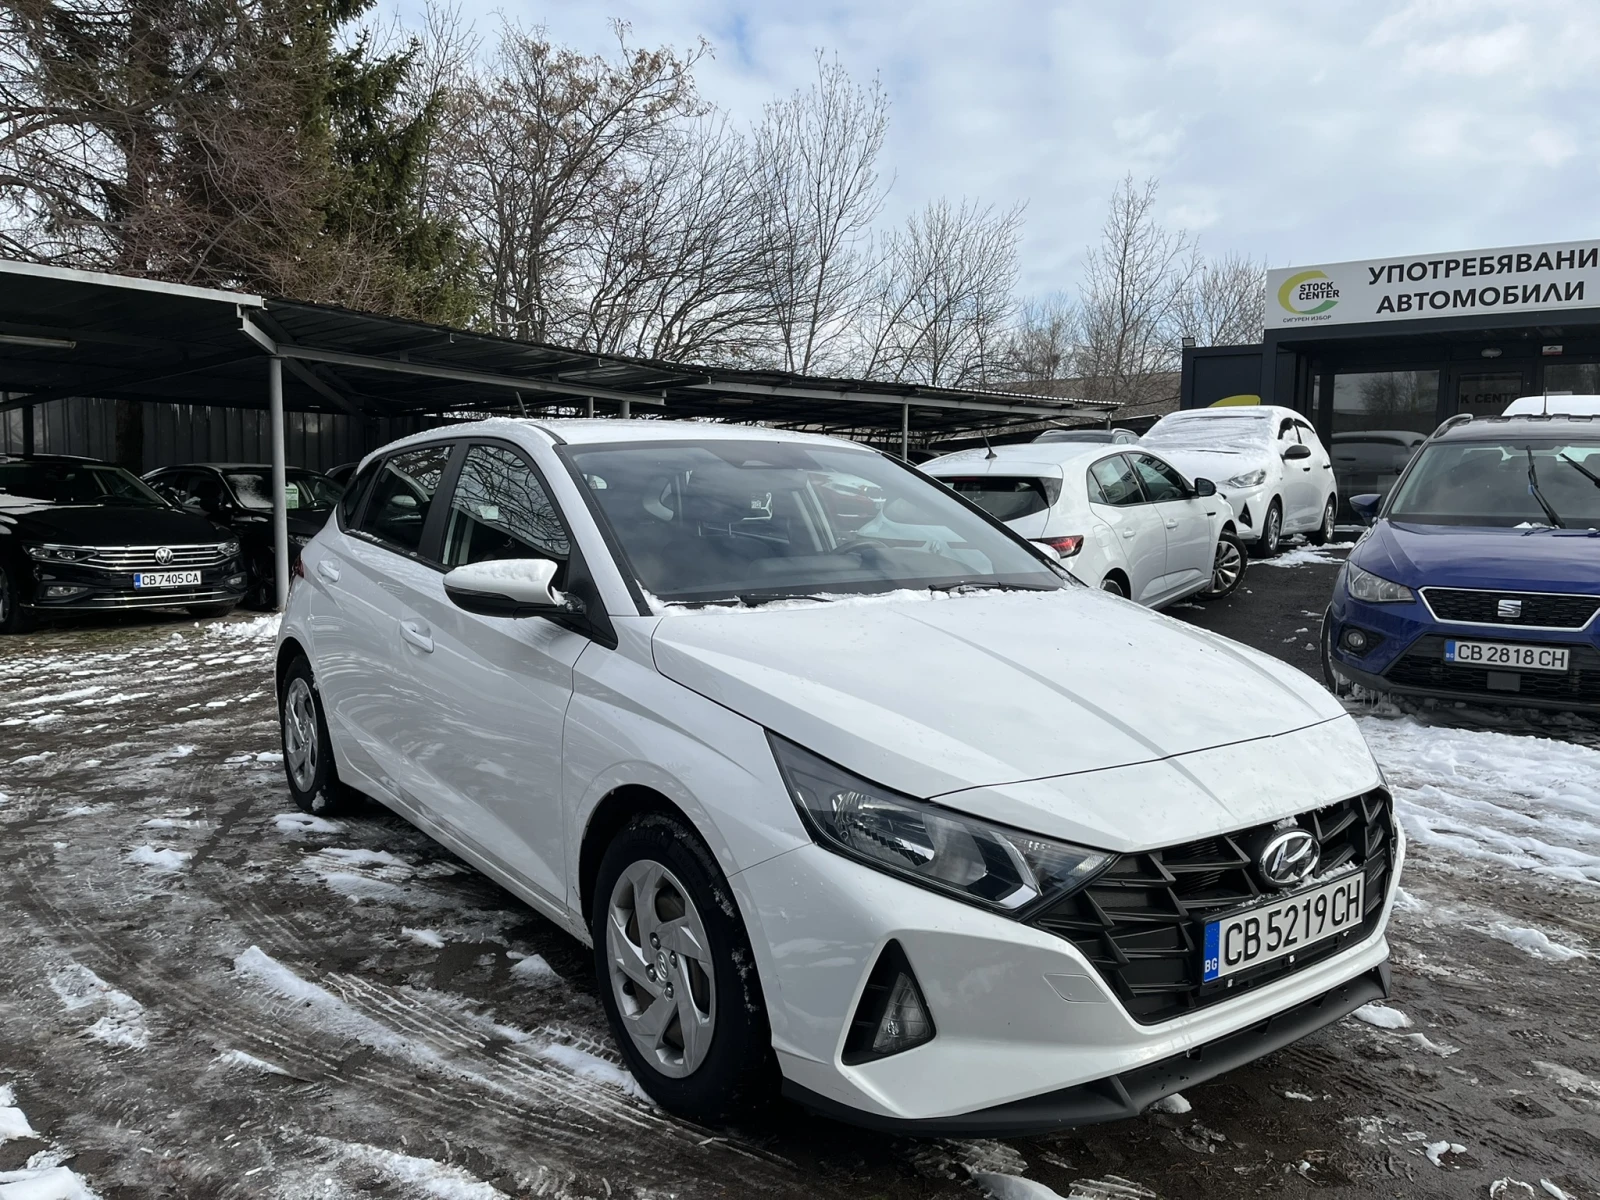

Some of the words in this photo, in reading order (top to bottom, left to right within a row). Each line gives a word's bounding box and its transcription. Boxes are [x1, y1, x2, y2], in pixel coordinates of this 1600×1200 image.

[1368, 248, 1598, 285] УПОТРЕБЯВАНИ
[1298, 289, 1340, 300] CENTER
[1299, 281, 1334, 292] STOCK
[1376, 281, 1584, 314] АВТОМОБИЛИ
[1486, 647, 1534, 665] 2818
[1204, 957, 1218, 973] BG
